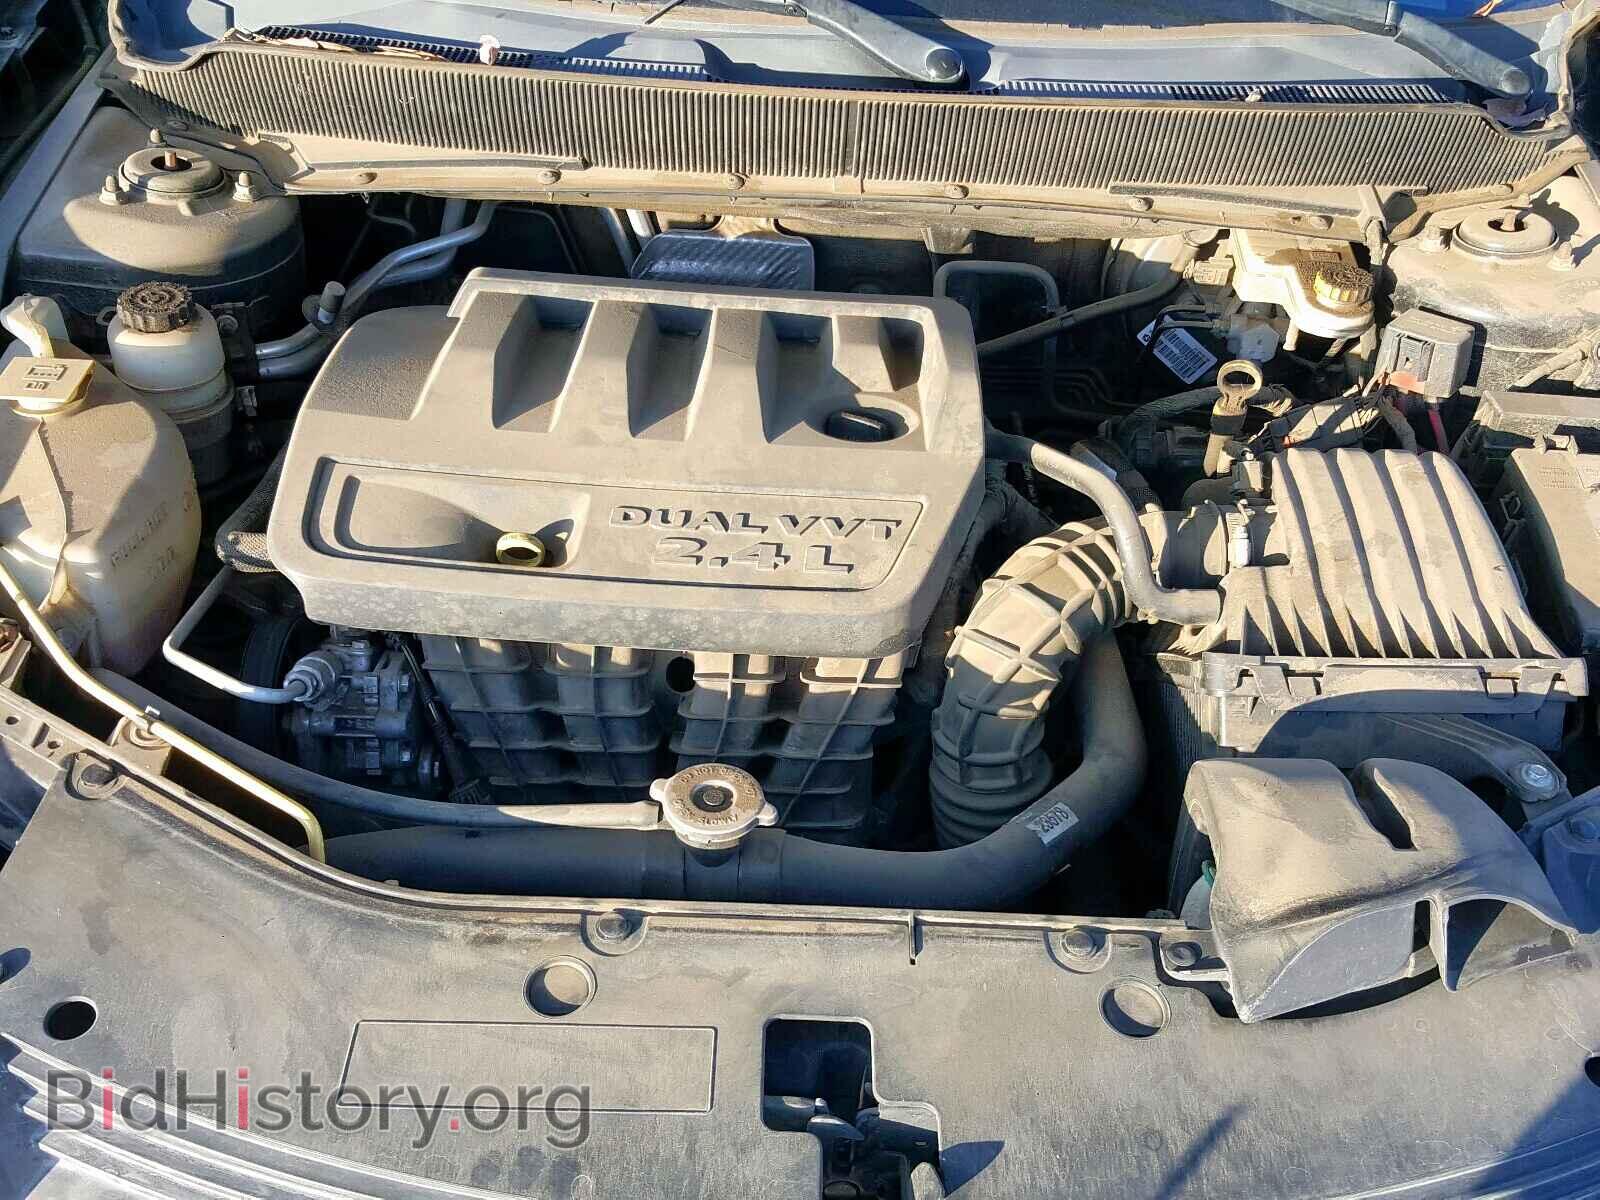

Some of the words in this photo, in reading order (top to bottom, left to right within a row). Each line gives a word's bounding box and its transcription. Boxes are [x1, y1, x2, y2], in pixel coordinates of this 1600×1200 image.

[609, 505, 769, 534] DUAL
[777, 514, 903, 540] VVT
[697, 812, 738, 826] SLOWLY
